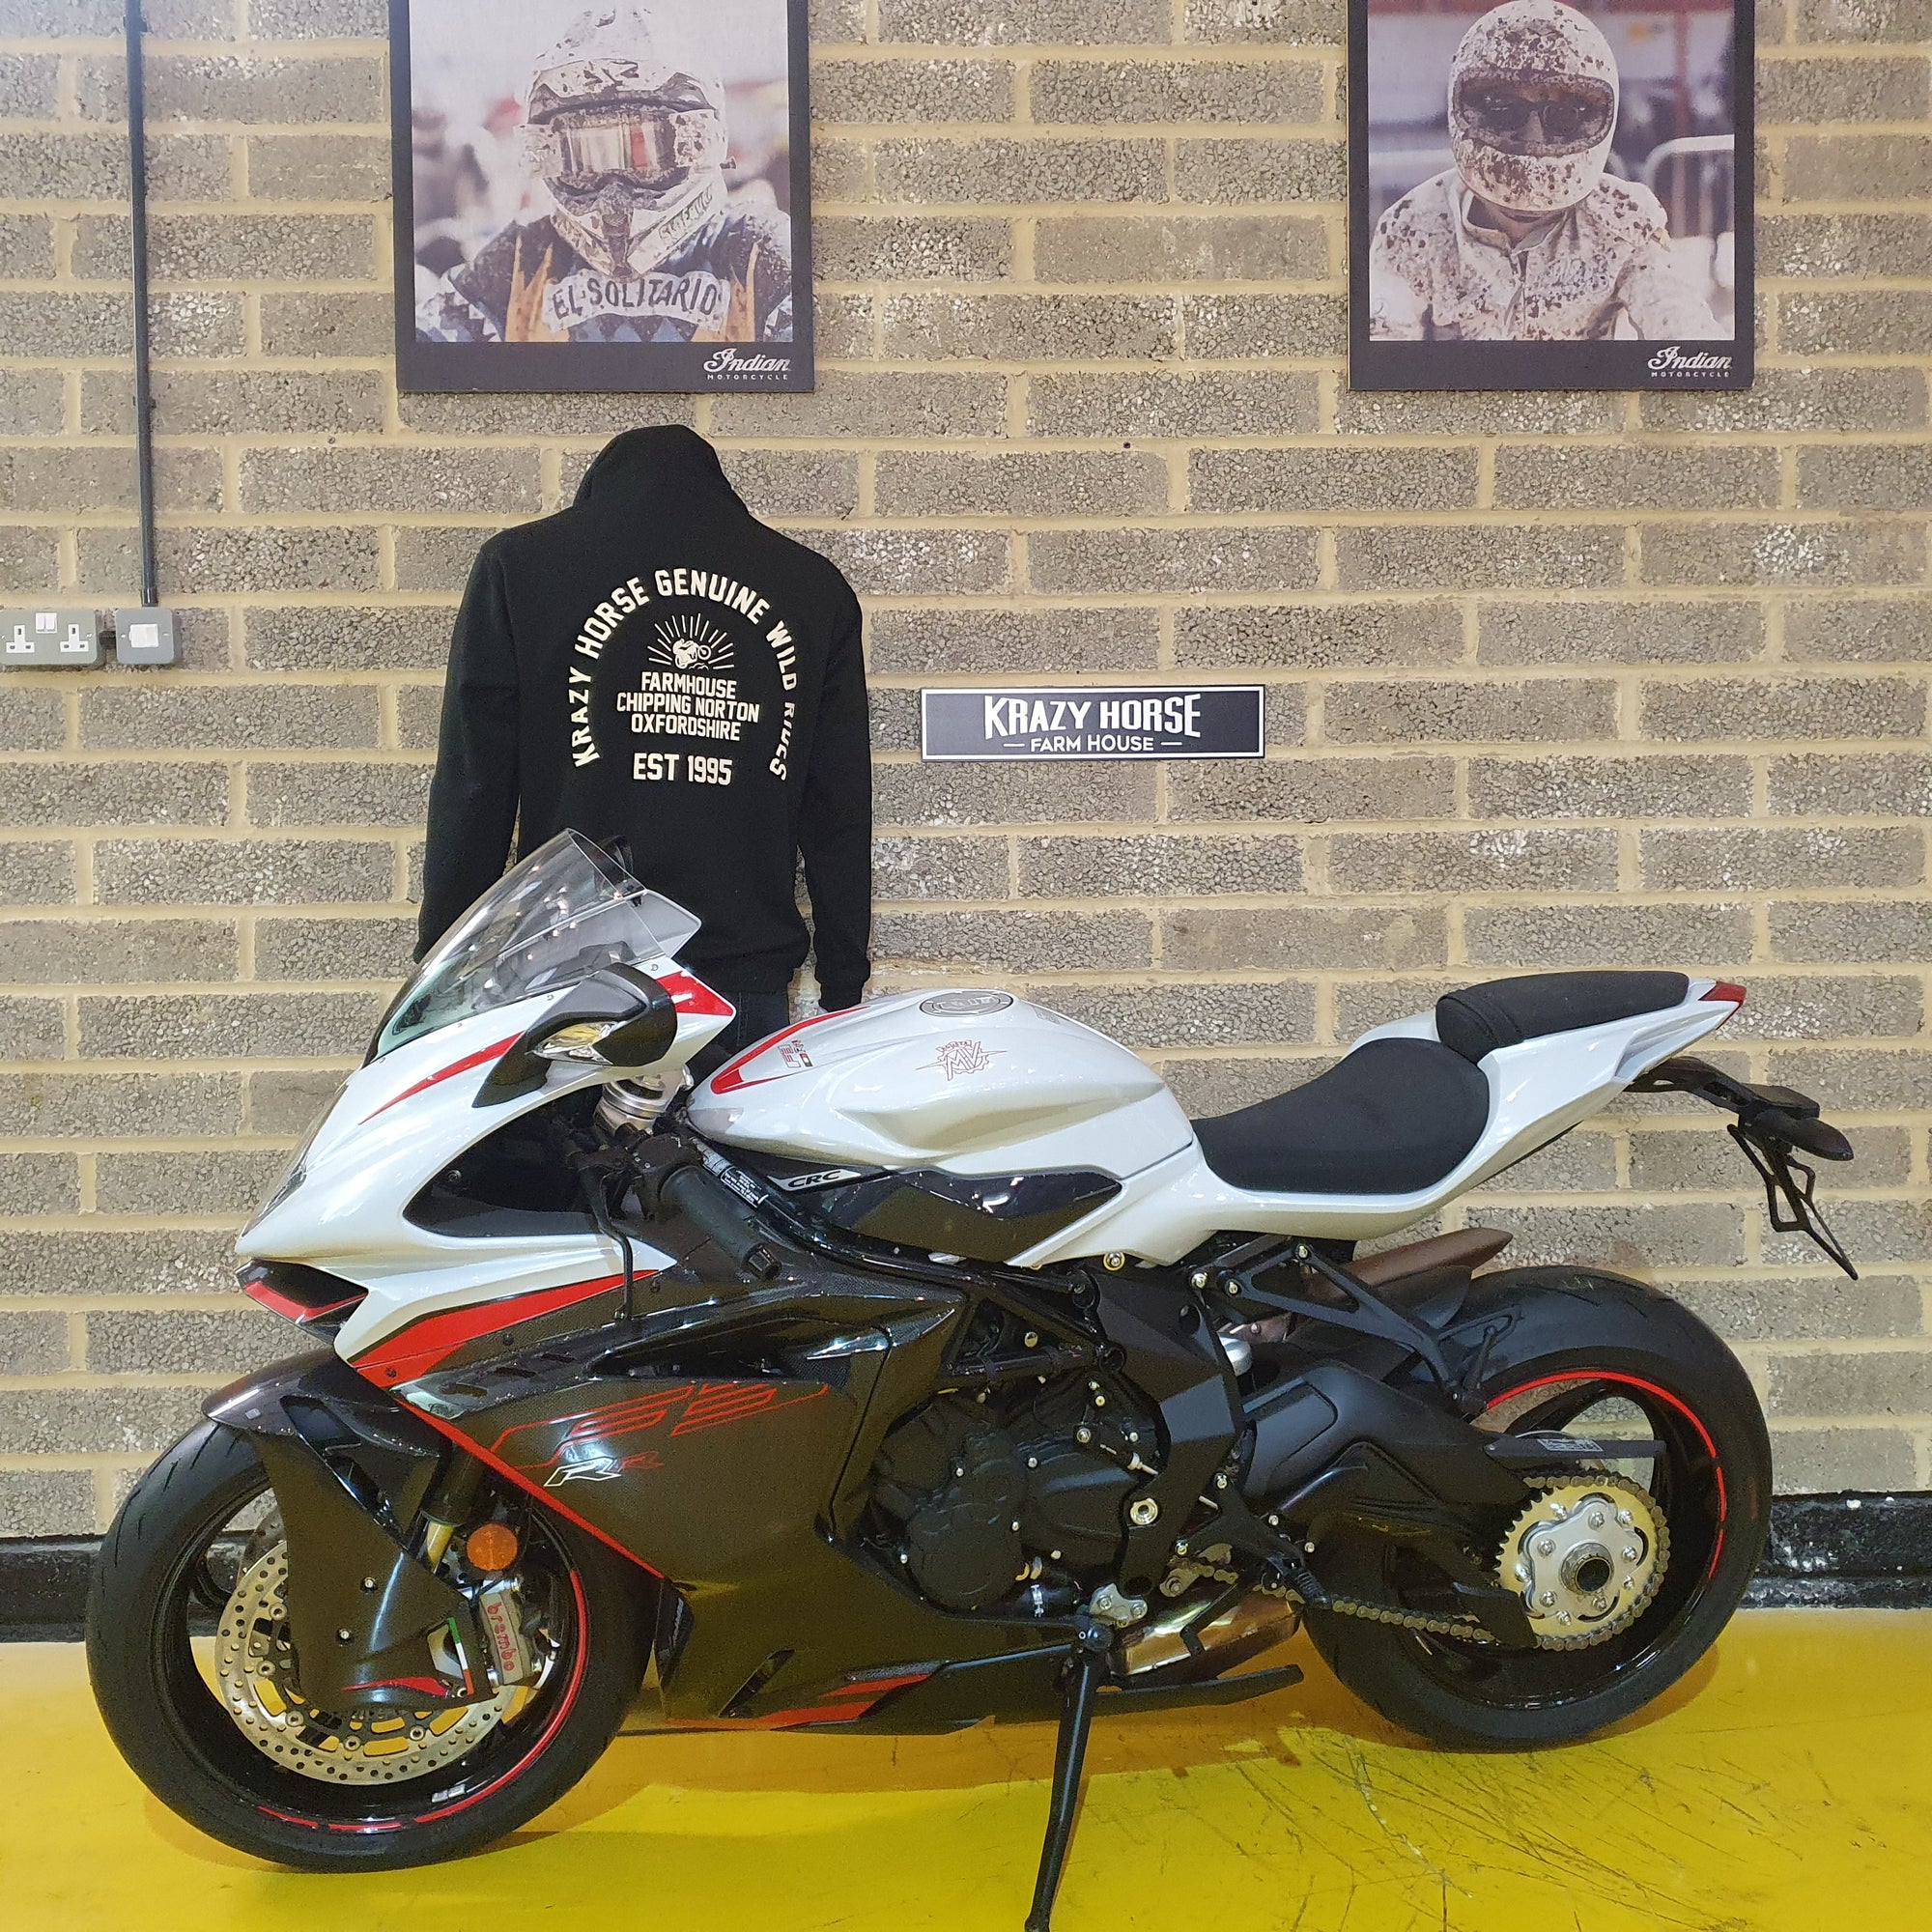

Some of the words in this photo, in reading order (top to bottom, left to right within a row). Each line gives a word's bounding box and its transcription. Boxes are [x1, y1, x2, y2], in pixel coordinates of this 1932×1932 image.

[553, 285, 582, 320] EL
[586, 277, 718, 316] SOLITARIO
[703, 348, 791, 373] Indian
[1647, 346, 1733, 370] Indian
[654, 568, 771, 625] GENUINE
[574, 577, 651, 660] HORSE
[766, 620, 797, 692] WILD
[640, 671, 737, 699] FARMHOUSE
[568, 666, 601, 768] KRAZY
[616, 692, 692, 715] CHIPPING
[695, 696, 760, 724] NORTON
[983, 695, 1092, 740] KRAZY
[1099, 693, 1202, 739] HORSE
[631, 713, 742, 741] OXFORDSHIRE
[1030, 736, 1082, 753] FARM
[1088, 734, 1154, 752] HOUSE
[633, 753, 680, 781] EST
[687, 754, 733, 785] 1995
[787, 1170, 841, 1188] CRC
[487, 1602, 518, 1671] brembo
